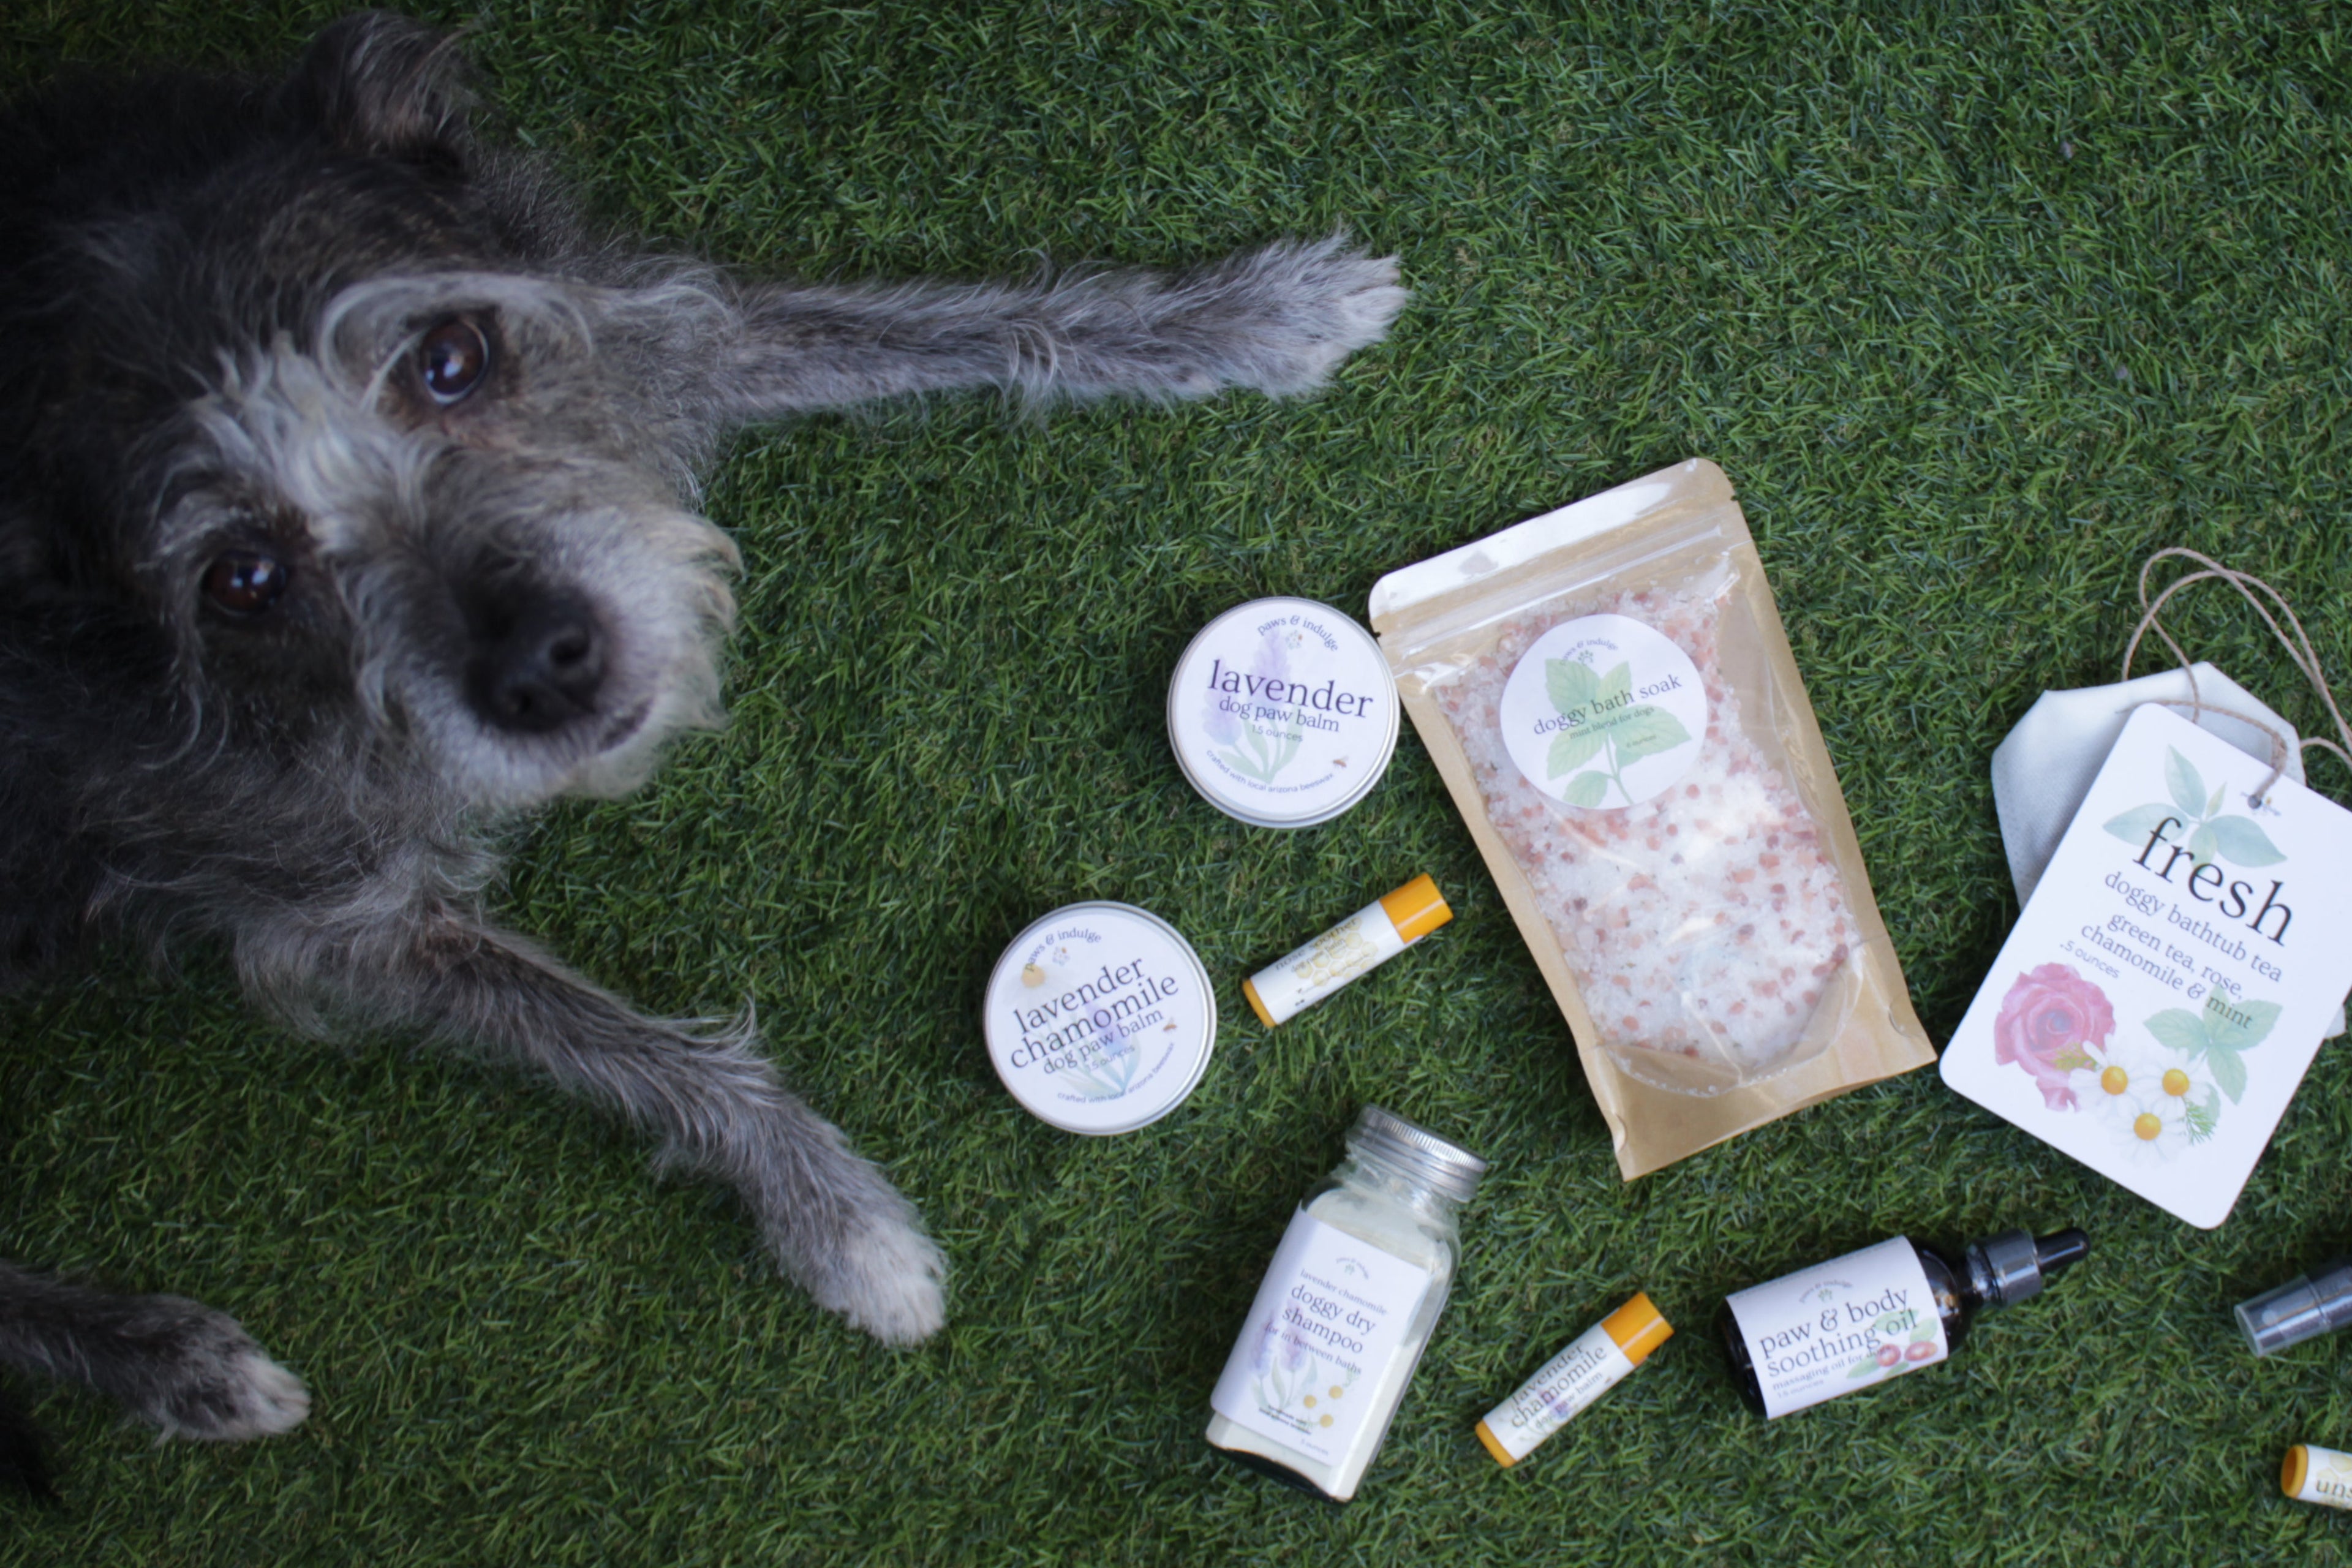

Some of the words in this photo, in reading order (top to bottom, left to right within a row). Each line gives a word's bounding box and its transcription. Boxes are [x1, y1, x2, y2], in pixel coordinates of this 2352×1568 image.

[1257, 617, 1286, 636] paws
[1289, 615, 1300, 625] &
[1303, 617, 1338, 652] indulge
[1207, 659, 1373, 718] lavender
[1219, 696, 1253, 720] dog
[1254, 706, 1292, 722] paw
[1296, 709, 1340, 732] balm
[1534, 706, 1588, 735] doggy
[1590, 690, 1636, 715] bath
[1639, 674, 1682, 699] soak
[1265, 729, 1303, 742] ounces
[1570, 728, 1591, 739] mint
[1619, 714, 1632, 723] for
[1634, 706, 1654, 717] dogs
[1206, 750, 1229, 774] crafted
[1229, 771, 1246, 784] with
[1248, 779, 1266, 791] local
[1300, 772, 1334, 791] beeswax
[2133, 816, 2292, 947] fresh
[1046, 935, 1055, 945] &
[1058, 927, 1102, 943] indulge
[2105, 872, 2165, 916] doggy
[2167, 904, 2247, 962] bathtub
[2250, 954, 2283, 982] tea
[2075, 948, 2120, 979] ounces
[2081, 925, 2184, 990] chamomile
[2187, 982, 2207, 1000] &
[2206, 996, 2253, 1029] mint
[2108, 914, 2162, 951] green
[2165, 944, 2195, 973] tea,
[2201, 966, 2244, 1000] rose,
[1011, 976, 1178, 1069] chamomile
[1014, 959, 1145, 1035] lavender
[1044, 1048, 1077, 1074] dog
[1079, 1031, 1114, 1060] paw
[1117, 1009, 1164, 1038] balm
[1101, 1045, 1135, 1066] ounces
[1057, 1092, 1086, 1102] crafted
[1291, 1284, 1344, 1321] doggy
[1346, 1310, 1376, 1336] dry
[1300, 1268, 1337, 1292] lavender
[1338, 1289, 1387, 1315] chamomile
[1265, 1322, 1280, 1336] for
[1281, 1332, 1292, 1341] in
[1294, 1335, 1333, 1363] between
[1335, 1356, 1362, 1375] baths
[1283, 1307, 1363, 1354] shampoo
[1759, 1321, 1812, 1360] paw
[1820, 1308, 1839, 1332] &
[1845, 1287, 1909, 1324] body
[1767, 1324, 1881, 1378] soothing
[1885, 1308, 1918, 1336] oil
[1511, 1346, 1607, 1428] chamomile
[1512, 1346, 1584, 1405] lavender
[1773, 1365, 1830, 1390] massaging
[1831, 1361, 1845, 1371] oil
[1847, 1354, 1863, 1365] for
